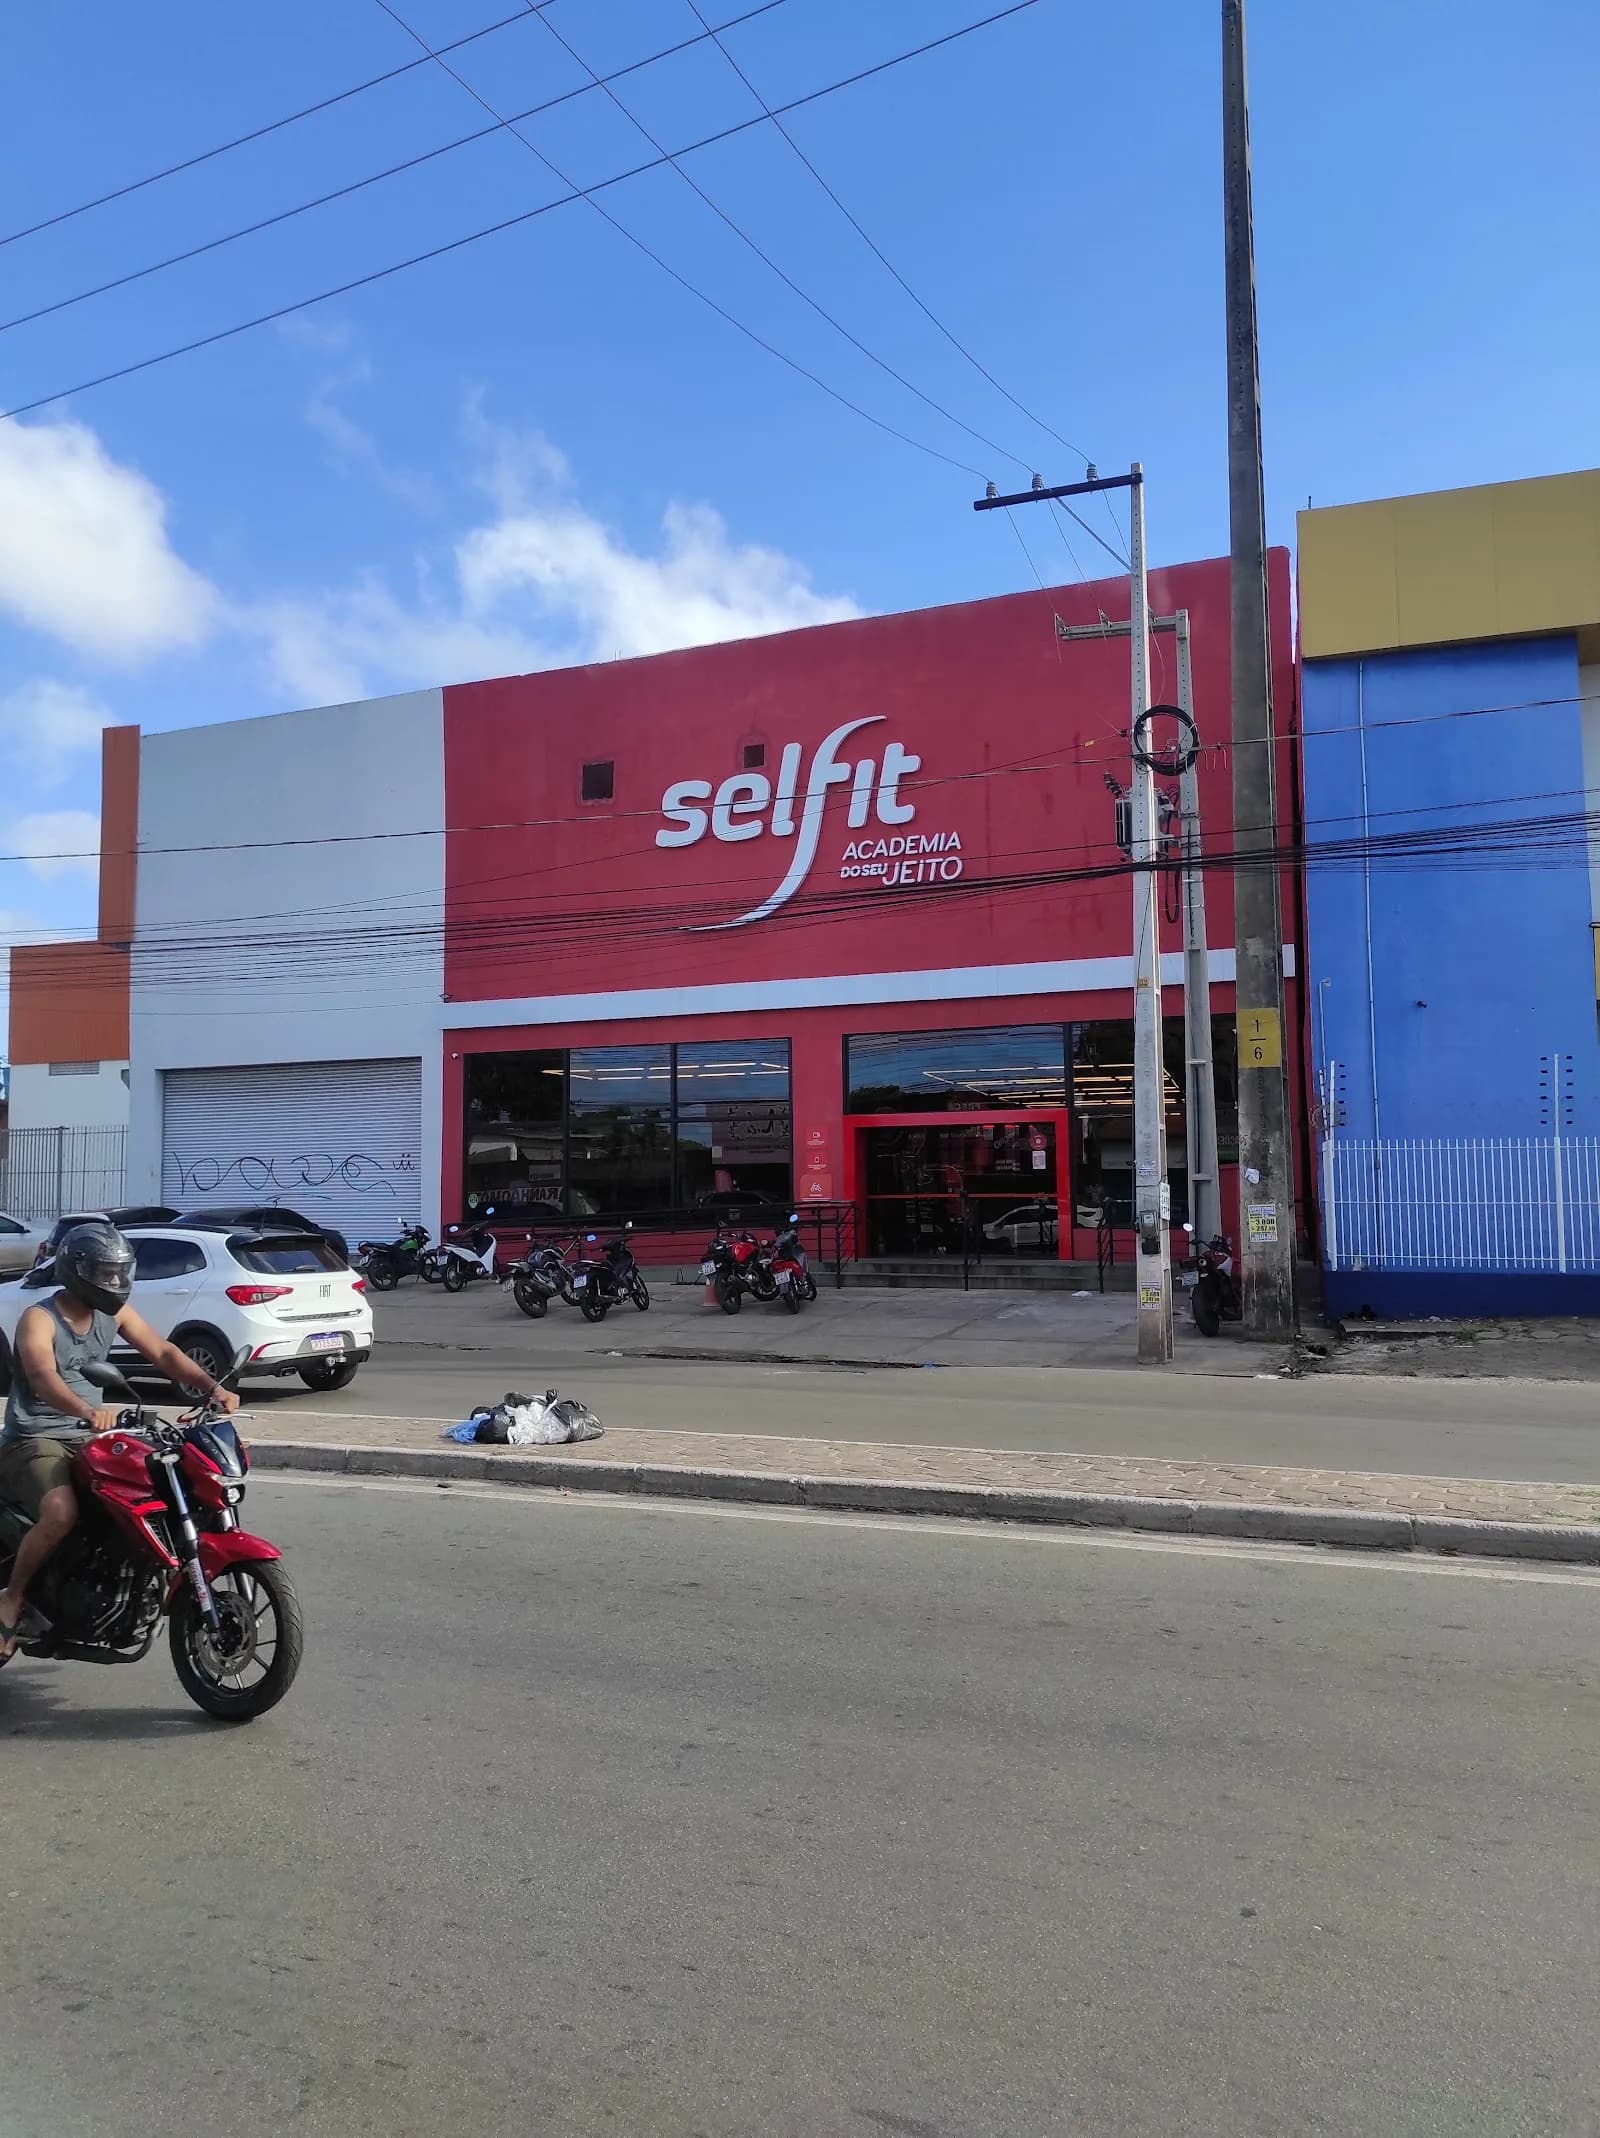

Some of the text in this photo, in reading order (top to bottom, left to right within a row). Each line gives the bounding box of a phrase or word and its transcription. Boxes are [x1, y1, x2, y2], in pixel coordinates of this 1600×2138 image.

[655, 715, 921, 931] selfit
[842, 831, 962, 861] ACADEMIA
[840, 856, 963, 887] DO SEU JEITO
[1254, 1019, 1260, 1033] 1
[1254, 1046, 1263, 1060] 6
[319, 1284, 332, 1298] FIAT
